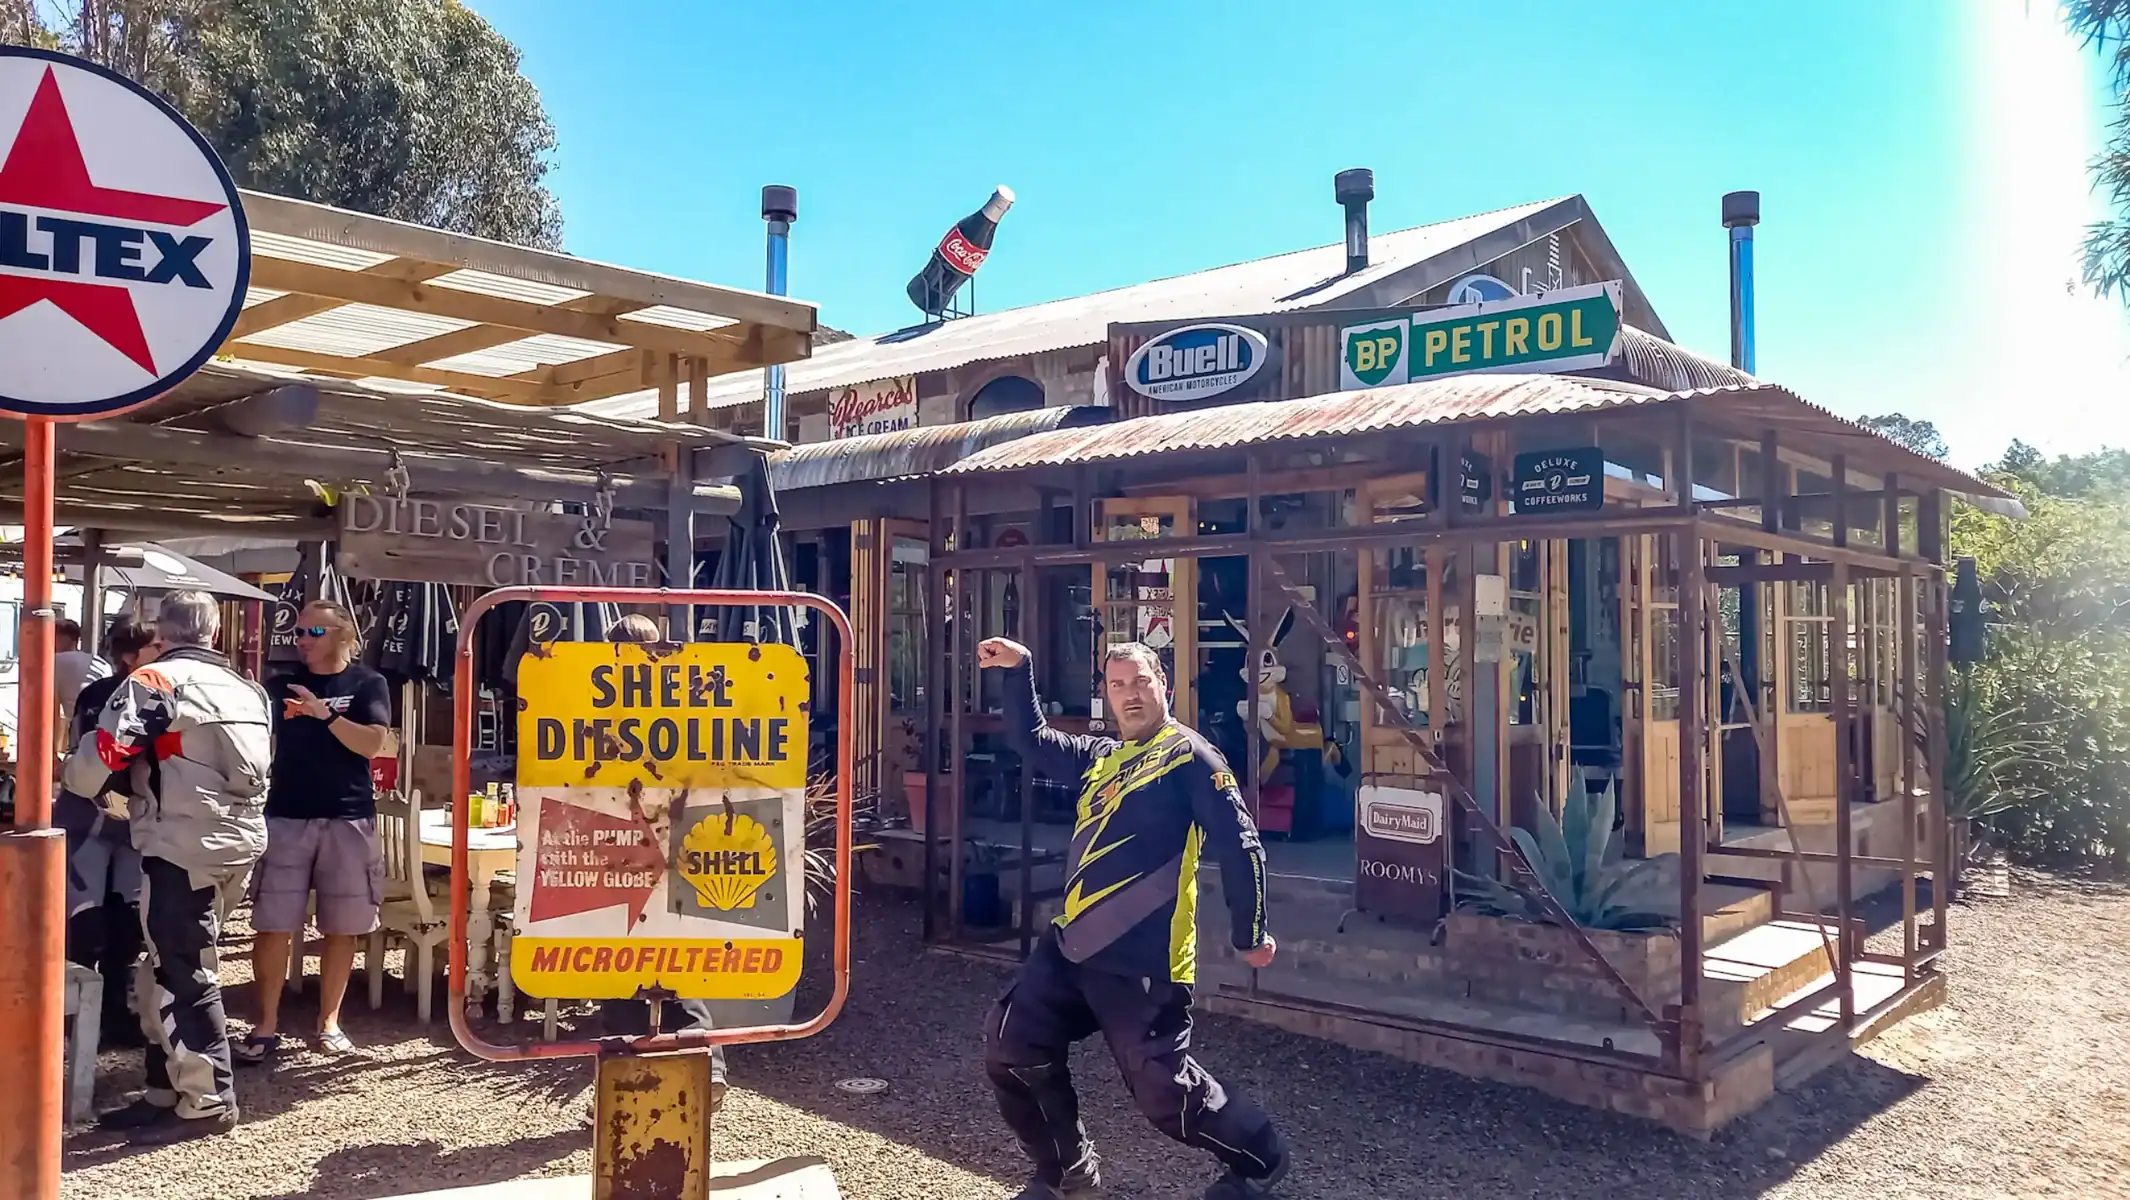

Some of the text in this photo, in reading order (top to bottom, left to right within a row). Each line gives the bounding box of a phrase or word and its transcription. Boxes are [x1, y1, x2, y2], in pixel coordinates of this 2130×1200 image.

[0, 210, 214, 290] LTEX
[1425, 309, 1592, 367] PETROL
[1149, 334, 1239, 380] Buell
[1355, 337, 1397, 373] BP
[1148, 374, 1237, 395] AMERICAN MOTORCYCLES
[846, 417, 908, 438] ICE CREAM
[1534, 457, 1578, 473] DELUXE
[1524, 493, 1588, 506] COFFEEWORKS
[343, 493, 606, 551] DIESEL &
[591, 664, 733, 709] SHELL
[537, 717, 788, 761] DIESOLINE
[1373, 811, 1427, 830] DairyMaid
[593, 829, 644, 847] PUMP
[582, 850, 608, 866] the
[687, 850, 766, 875] SHELL
[540, 870, 655, 889] YELLOW GLOBE
[531, 946, 782, 974] MICROFILTERED
